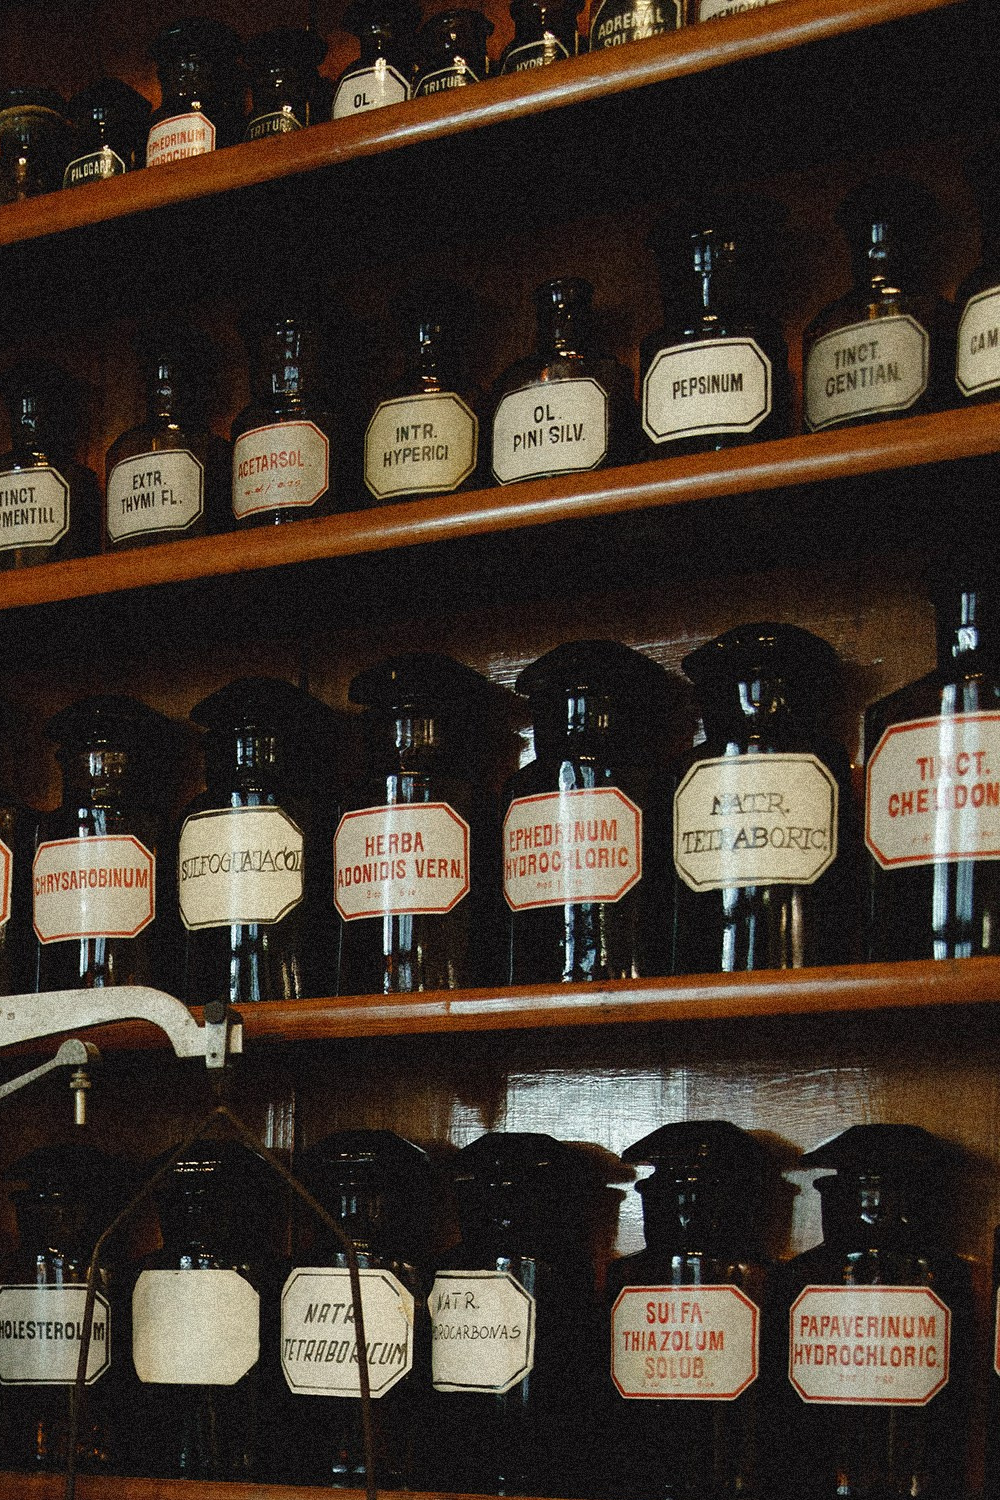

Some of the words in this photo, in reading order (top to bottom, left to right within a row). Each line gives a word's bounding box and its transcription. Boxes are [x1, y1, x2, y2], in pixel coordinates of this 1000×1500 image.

[834, 340, 882, 370] TINCT.
[673, 373, 743, 400] PEPSINUM
[825, 361, 901, 399] GENTIAN.
[533, 404, 562, 424] OL.
[395, 424, 438, 444] INTR.
[513, 426, 544, 453] PINI
[549, 423, 586, 445] SILV.
[383, 445, 449, 468] HYPERICI
[132, 470, 168, 491] EXTR.
[121, 494, 156, 515] THYMI
[160, 489, 184, 507] FL.
[364, 830, 425, 857] HERBA
[509, 820, 618, 853] EPHEDRINUM
[34, 867, 150, 898] CHRYSAROBINUM
[337, 856, 407, 888] ADONIDIS
[414, 855, 465, 882] VERN.
[799, 1315, 936, 1340] PAPAVERINUM
[622, 1331, 725, 1352] THIAZOLUM
[644, 1357, 708, 1380] SOLUB.
[793, 1345, 941, 1369] HYDROCHLORIC.
